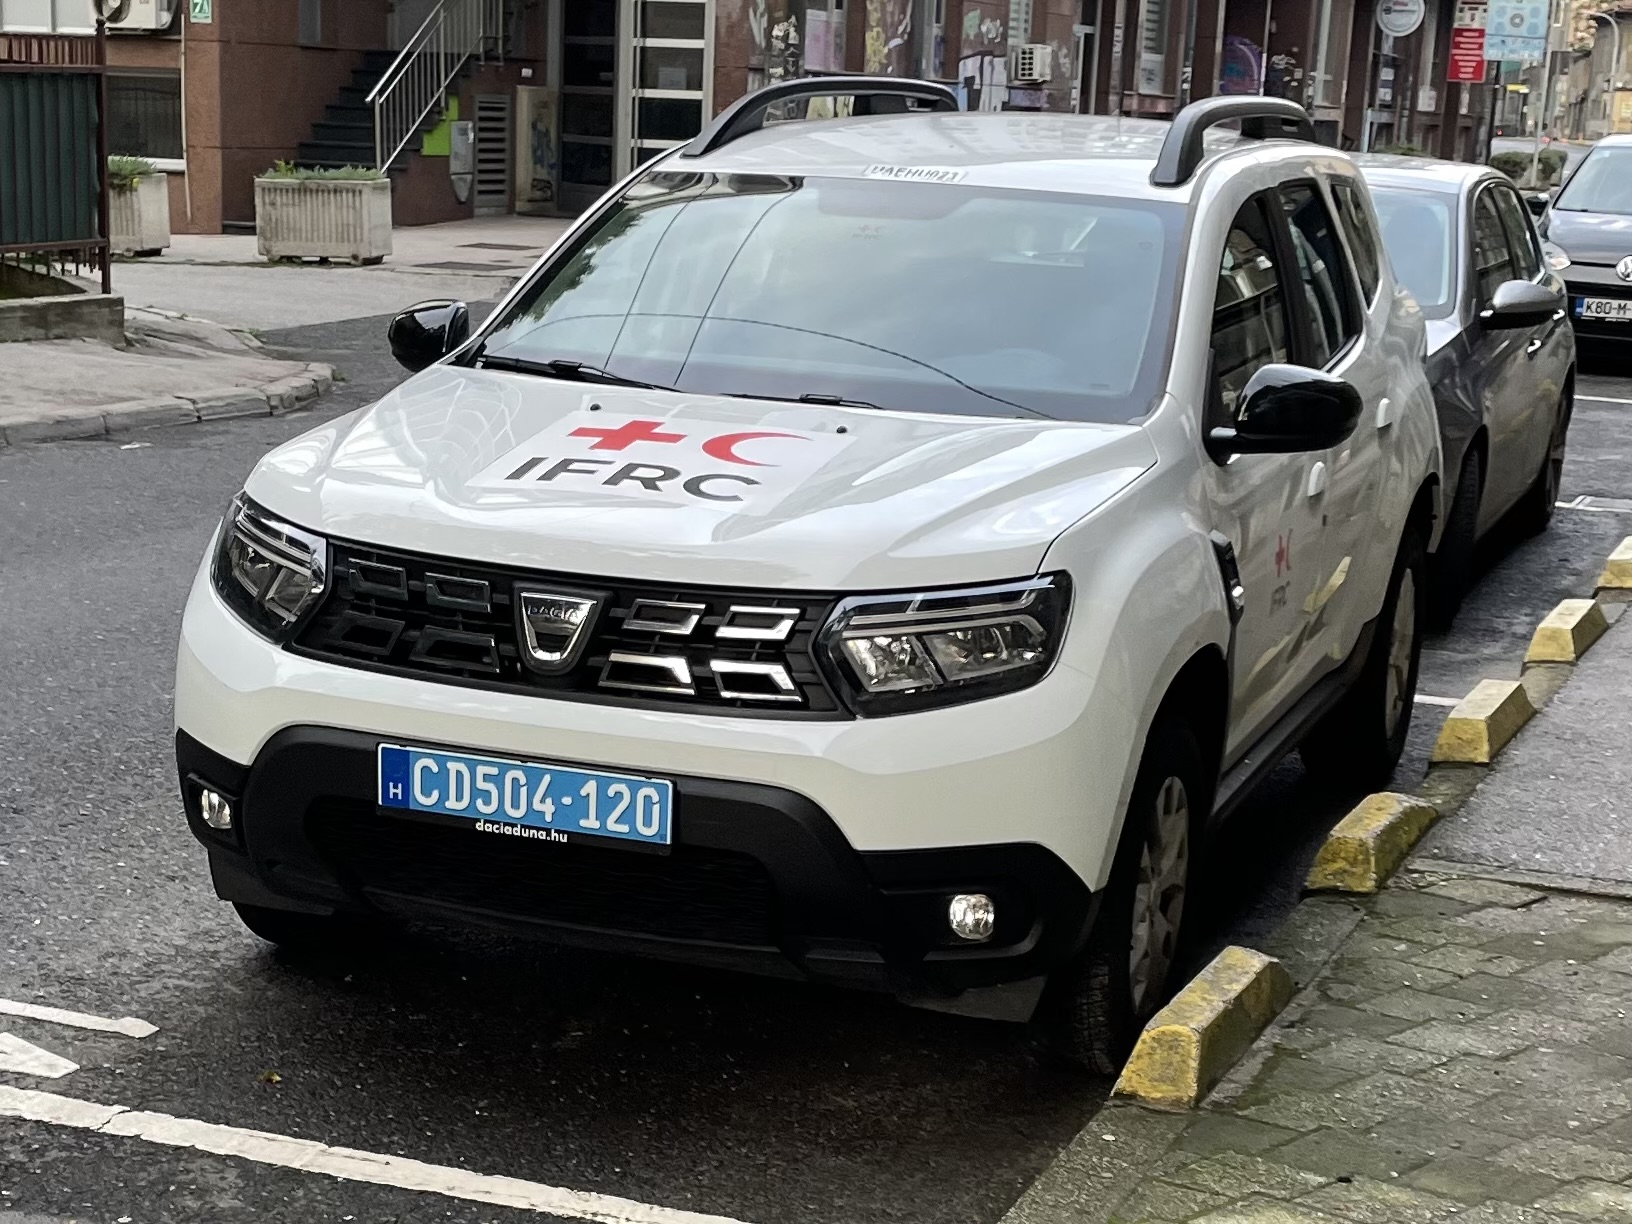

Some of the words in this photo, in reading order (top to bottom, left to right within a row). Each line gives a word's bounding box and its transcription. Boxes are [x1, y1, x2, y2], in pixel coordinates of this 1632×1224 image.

[505, 456, 761, 501] IFRC
[388, 781, 402, 800] H
[413, 757, 661, 837] CD504-120
[475, 818, 568, 843] daciaduna.hu
